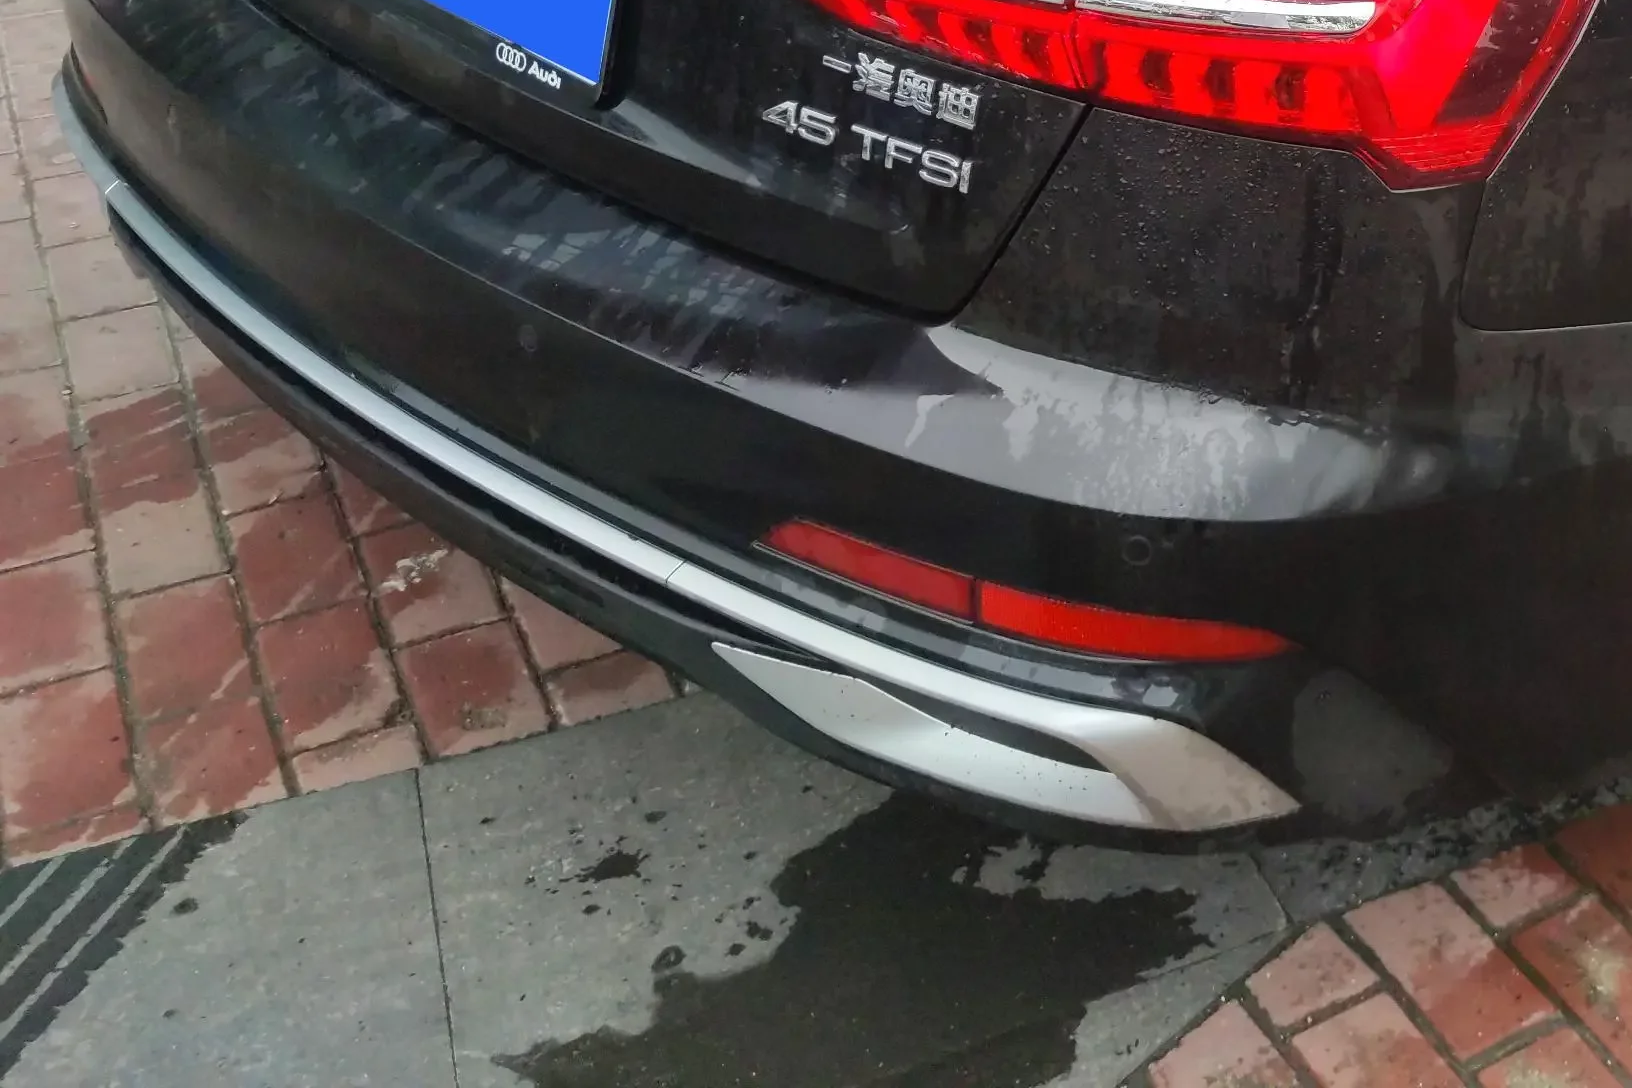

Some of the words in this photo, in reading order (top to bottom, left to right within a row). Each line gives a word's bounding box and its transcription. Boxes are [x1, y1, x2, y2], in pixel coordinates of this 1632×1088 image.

[528, 60, 562, 90] Audi
[822, 52, 981, 130] 一汽奥迪
[762, 100, 838, 146] 45
[851, 123, 972, 194] TFSI
